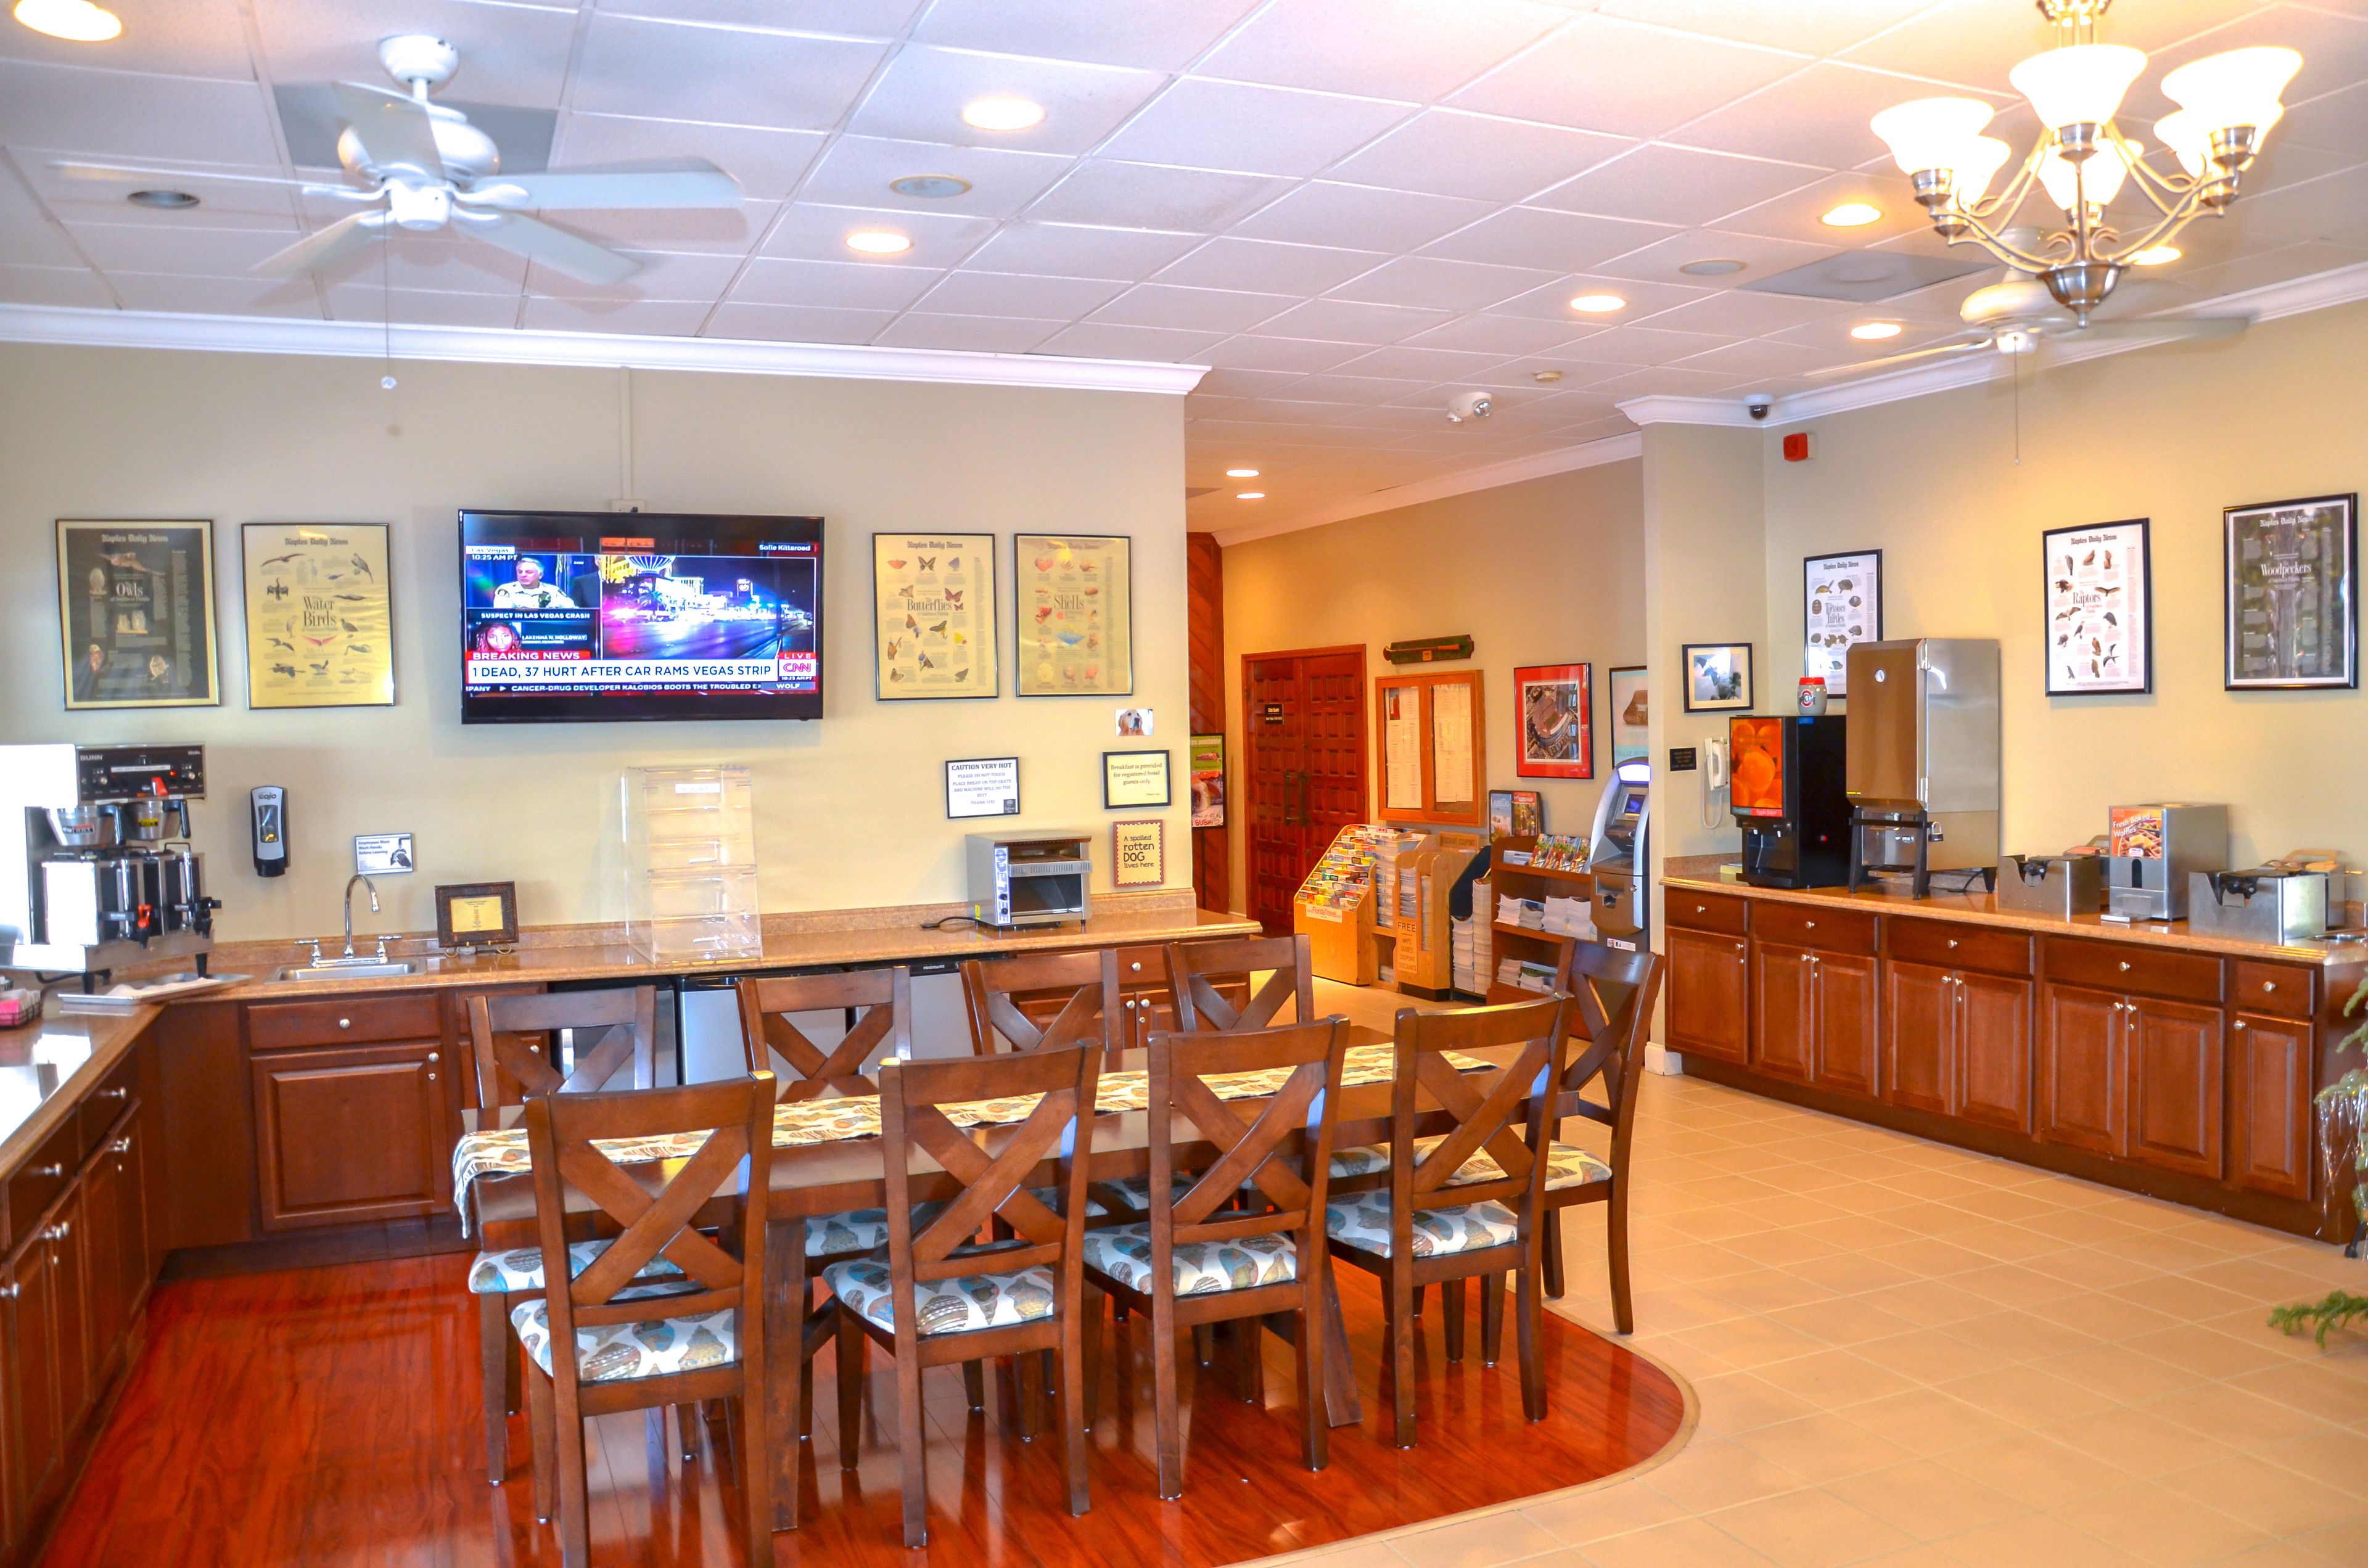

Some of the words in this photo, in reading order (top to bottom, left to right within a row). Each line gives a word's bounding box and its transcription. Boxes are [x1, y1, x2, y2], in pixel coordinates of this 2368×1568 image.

[2259, 520, 2279, 528] Naples
[2280, 517, 2296, 526] Daily
[101, 534, 126, 543] Naples
[128, 534, 147, 544] Daily
[149, 534, 168, 542] News
[310, 538, 328, 546] Daily
[2089, 535, 2102, 543] Daily
[929, 541, 945, 550] Daily
[2261, 562, 2312, 578] Woodpeckers
[117, 581, 144, 597] Owls
[303, 596, 335, 610] Water
[907, 598, 953, 611] Butterflies
[1053, 594, 1085, 610] Shells
[2073, 592, 2102, 607] Raptors
[303, 610, 337, 627] Birds
[472, 652, 539, 660] BREAKING
[543, 652, 580, 660] NEWS
[473, 668, 477, 676] 1
[482, 667, 521, 678] DEAD,
[525, 667, 539, 676] 37
[543, 667, 577, 676] HURT
[581, 667, 622, 676] AFTER
[625, 667, 651, 676] CAR
[655, 666, 689, 676] RAMS
[693, 666, 734, 676] VEGAS
[738, 666, 771, 675] STRIP
[783, 663, 811, 672] CNN
[1140, 762, 1162, 771] provided
[1122, 771, 1147, 779] registered
[2113, 819, 2129, 828] Fresh
[2131, 812, 2150, 824] Baked
[2113, 826, 2137, 837] Waffles
[1130, 834, 1152, 842] spoiled
[1124, 842, 1154, 852] rotten
[1123, 852, 1145, 863] DOG
[1397, 921, 1416, 932] FREE
